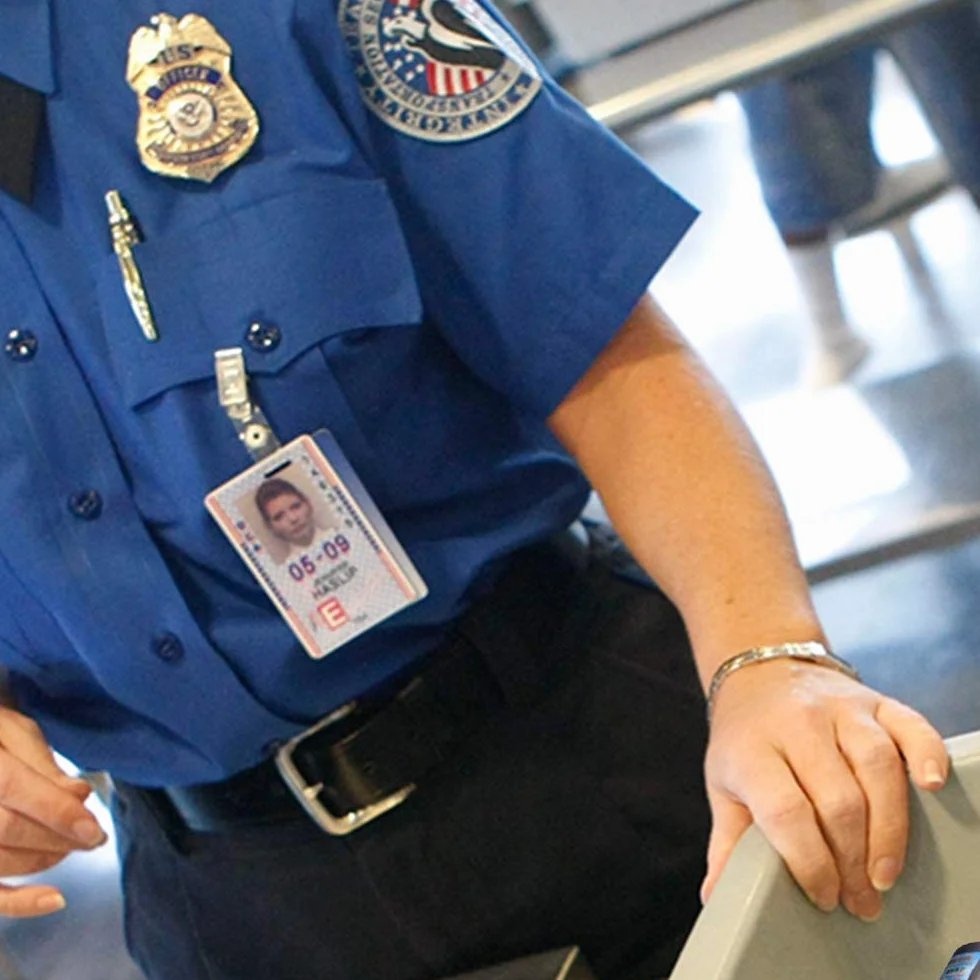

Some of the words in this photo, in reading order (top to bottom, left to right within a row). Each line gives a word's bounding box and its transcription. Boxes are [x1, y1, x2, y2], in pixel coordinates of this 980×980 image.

[362, 32, 497, 113] TRANSPORTATION
[364, 81, 514, 134] INTEGRITY
[288, 534, 351, 581] 05-09
[320, 599, 348, 628] E
